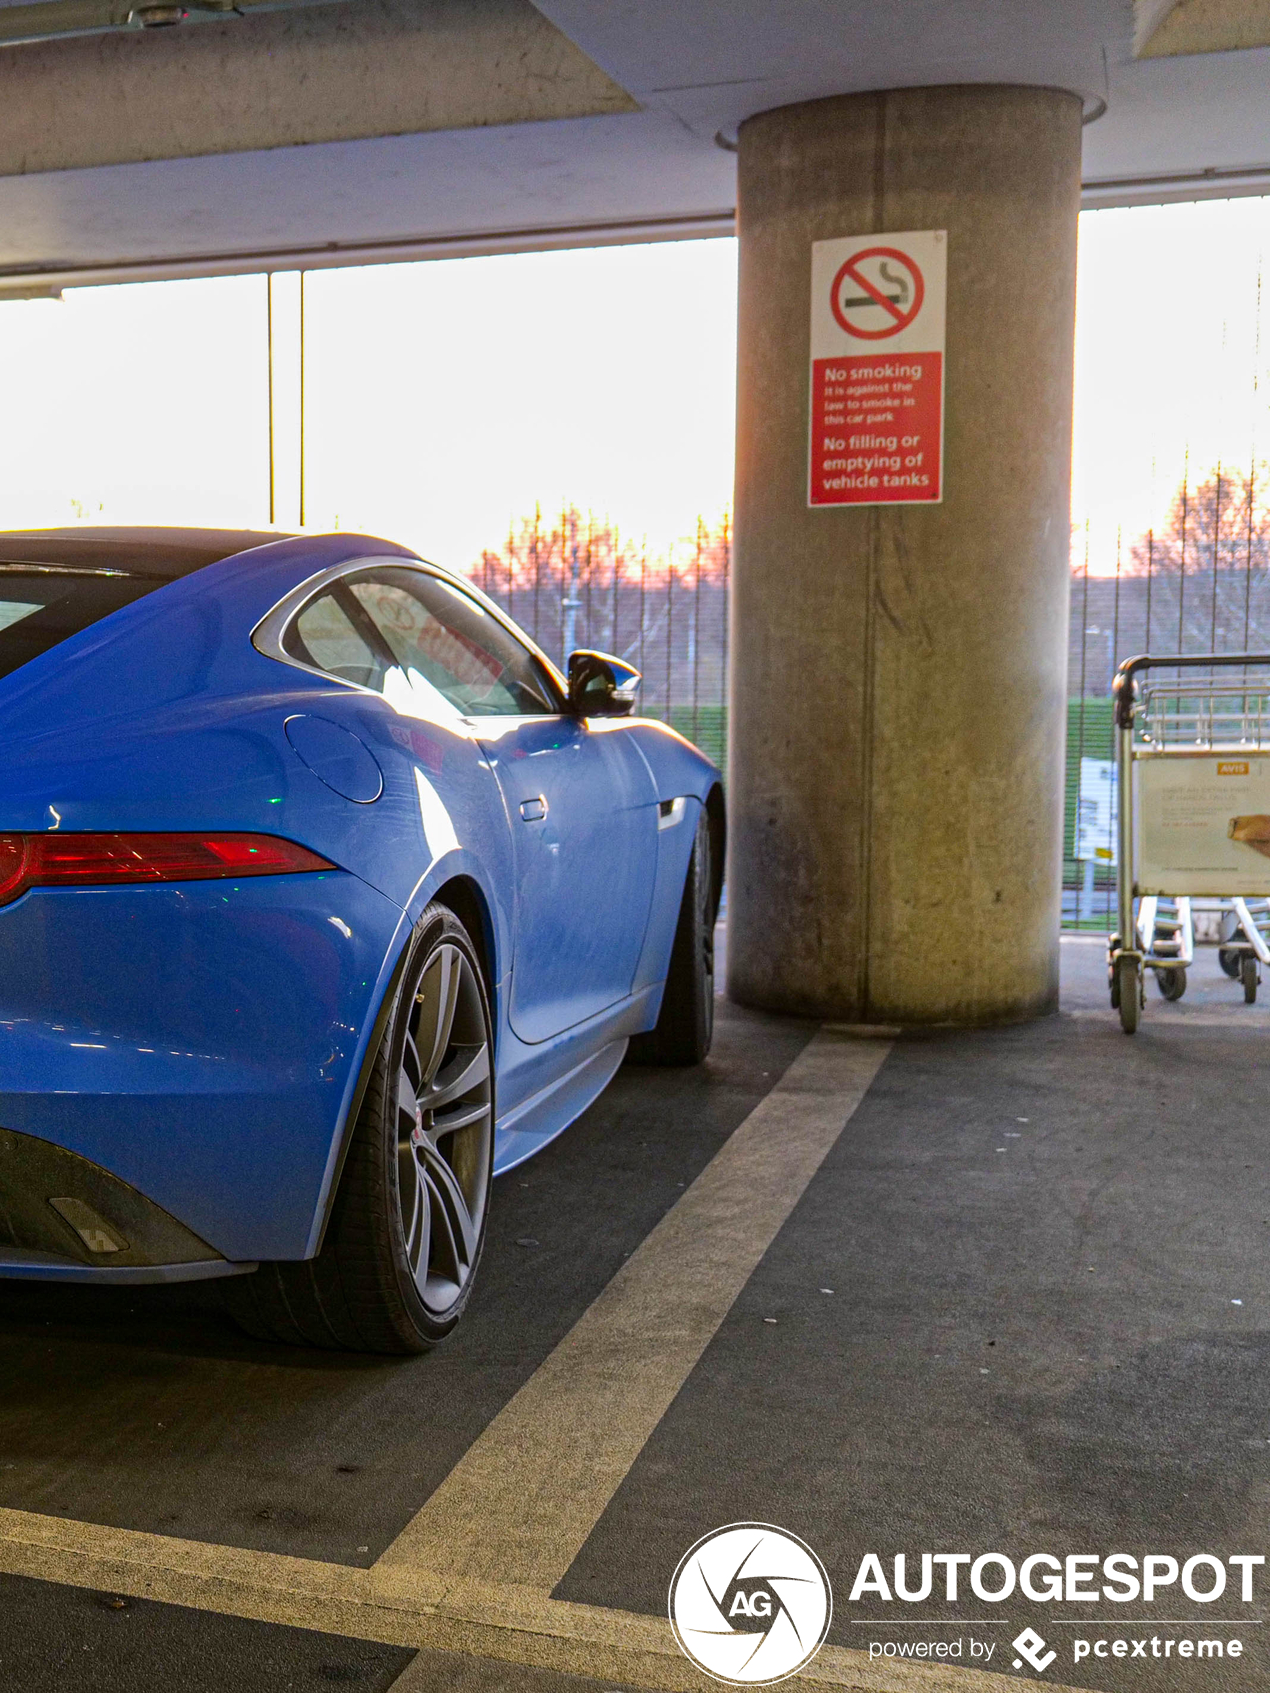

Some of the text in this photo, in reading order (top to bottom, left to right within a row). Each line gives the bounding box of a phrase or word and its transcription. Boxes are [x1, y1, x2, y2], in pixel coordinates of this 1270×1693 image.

[825, 363, 922, 381] No smoking
[835, 386, 844, 395] is
[847, 383, 889, 396] against
[892, 382, 913, 392] the
[825, 396, 915, 411] law to smoke in
[825, 411, 894, 425] this car park
[824, 434, 920, 452] No filling or
[823, 452, 923, 472] emptying of
[823, 472, 929, 489] vehicle tanks
[1220, 764, 1245, 774] AVIS
